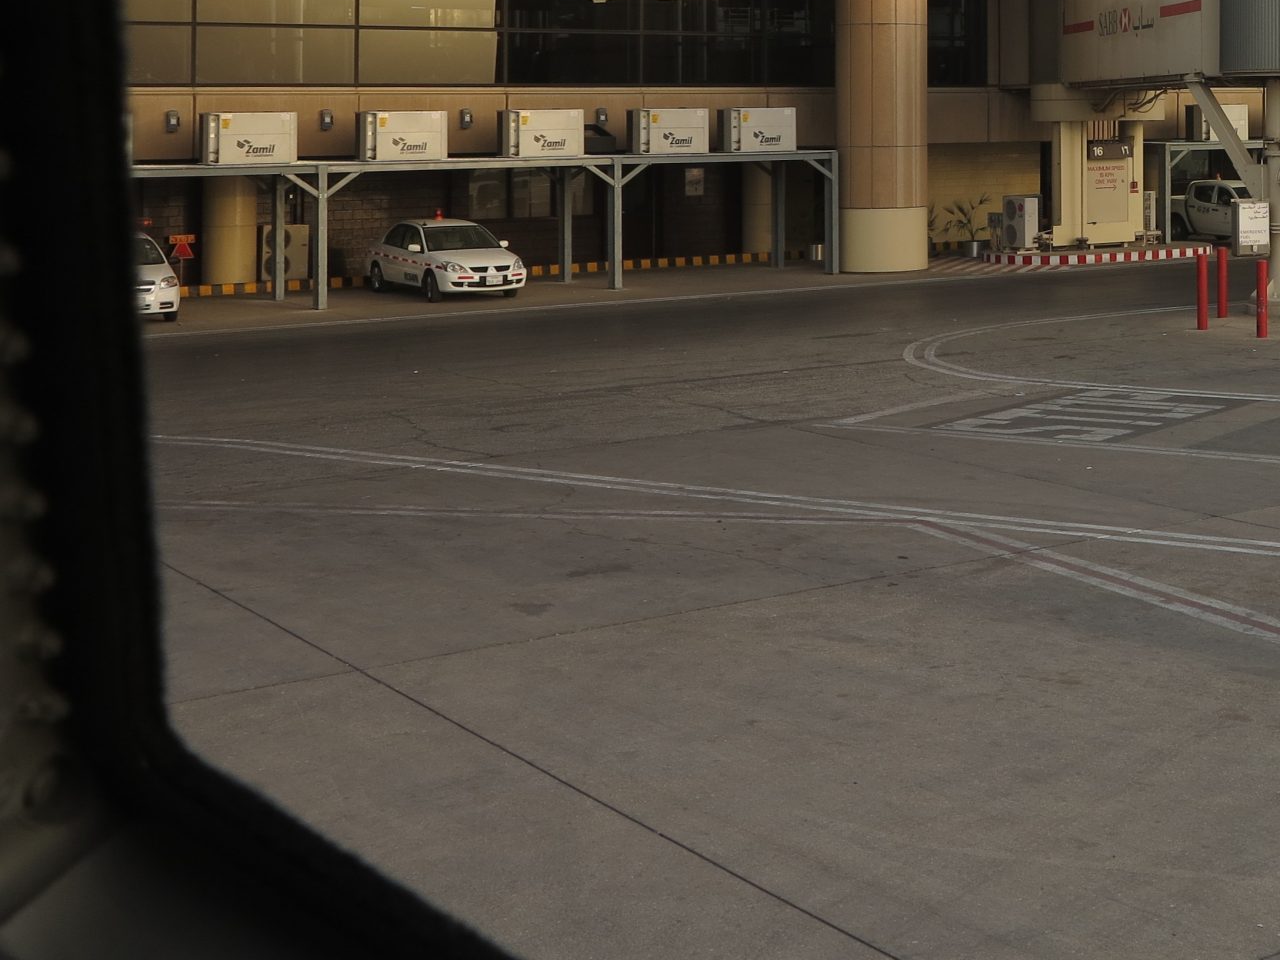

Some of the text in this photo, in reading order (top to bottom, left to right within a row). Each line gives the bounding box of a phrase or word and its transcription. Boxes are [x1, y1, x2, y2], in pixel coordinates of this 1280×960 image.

[1098, 9, 1118, 37] SABB
[541, 138, 567, 148] Zamil
[669, 136, 692, 145] Zamil
[759, 134, 781, 143] Zamil
[245, 143, 275, 154] Zamil
[400, 141, 427, 151] Zamil
[1092, 146, 1103, 157] 16
